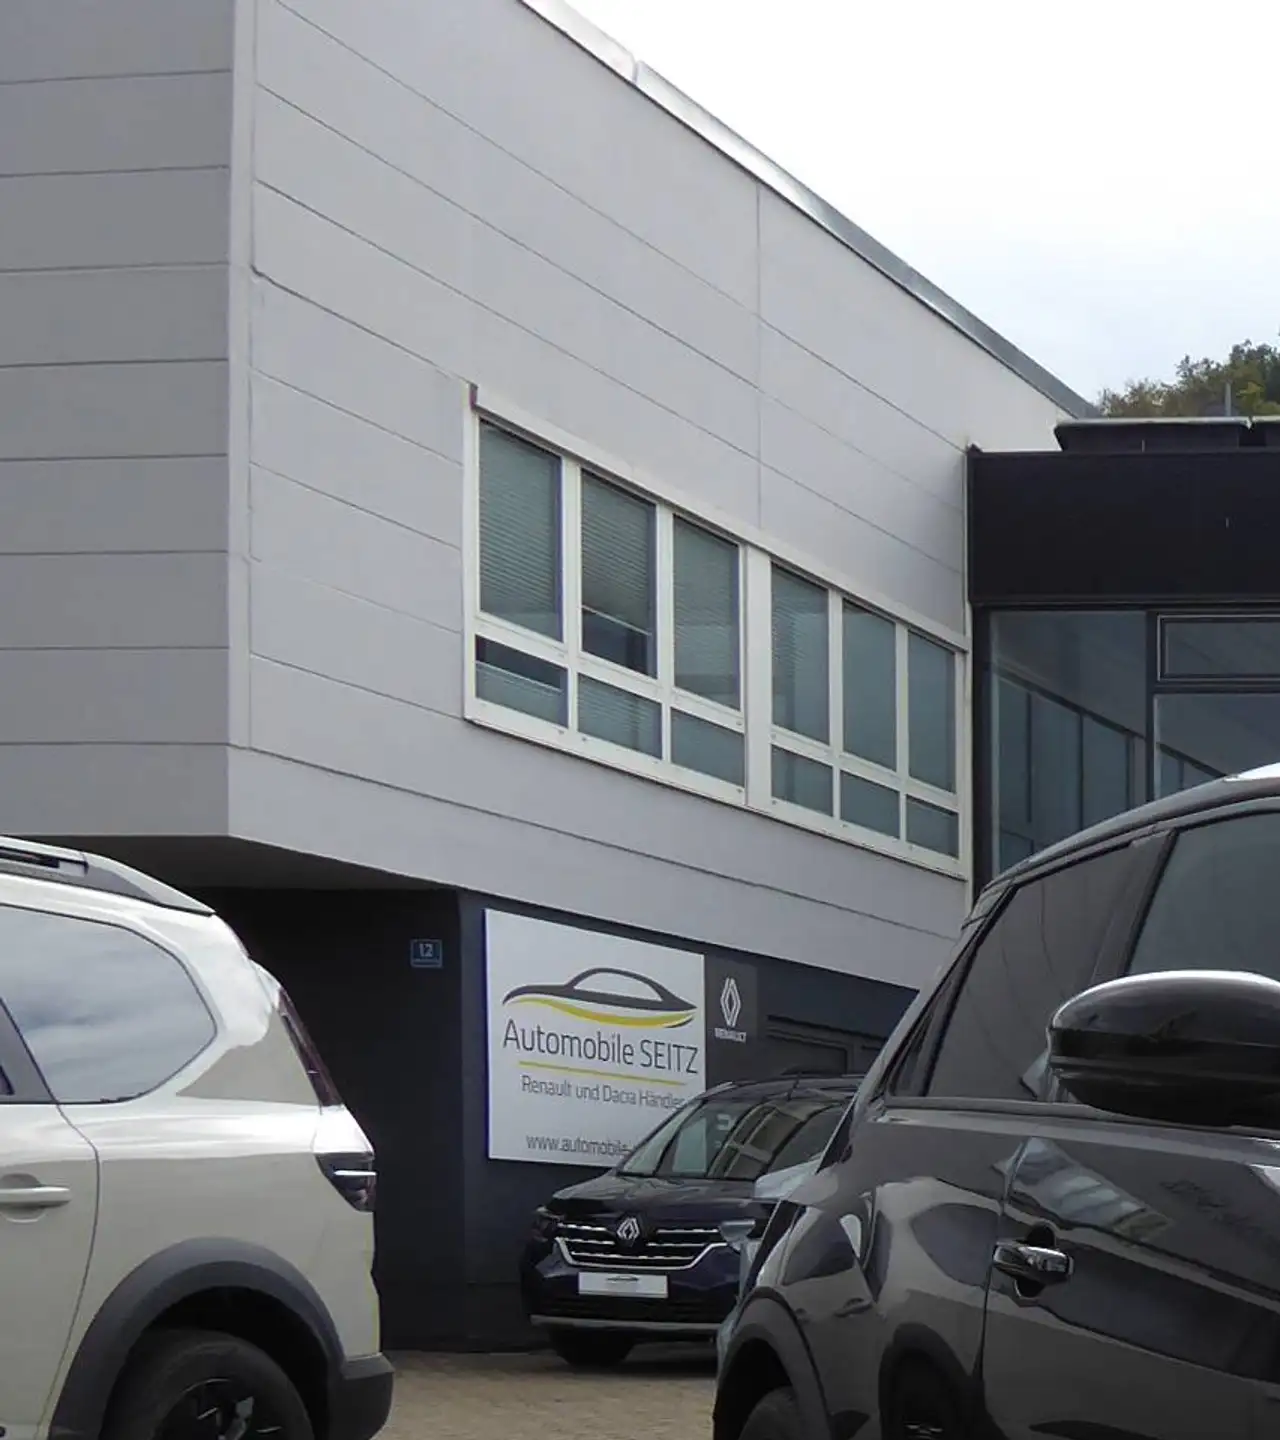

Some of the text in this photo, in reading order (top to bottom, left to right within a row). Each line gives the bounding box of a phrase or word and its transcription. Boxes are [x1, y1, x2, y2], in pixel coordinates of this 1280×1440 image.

[503, 1019, 699, 1074] Automobile SEITZ
[521, 1074, 572, 1098] Renault
[575, 1084, 600, 1101] und
[603, 1085, 637, 1106] Dacia
